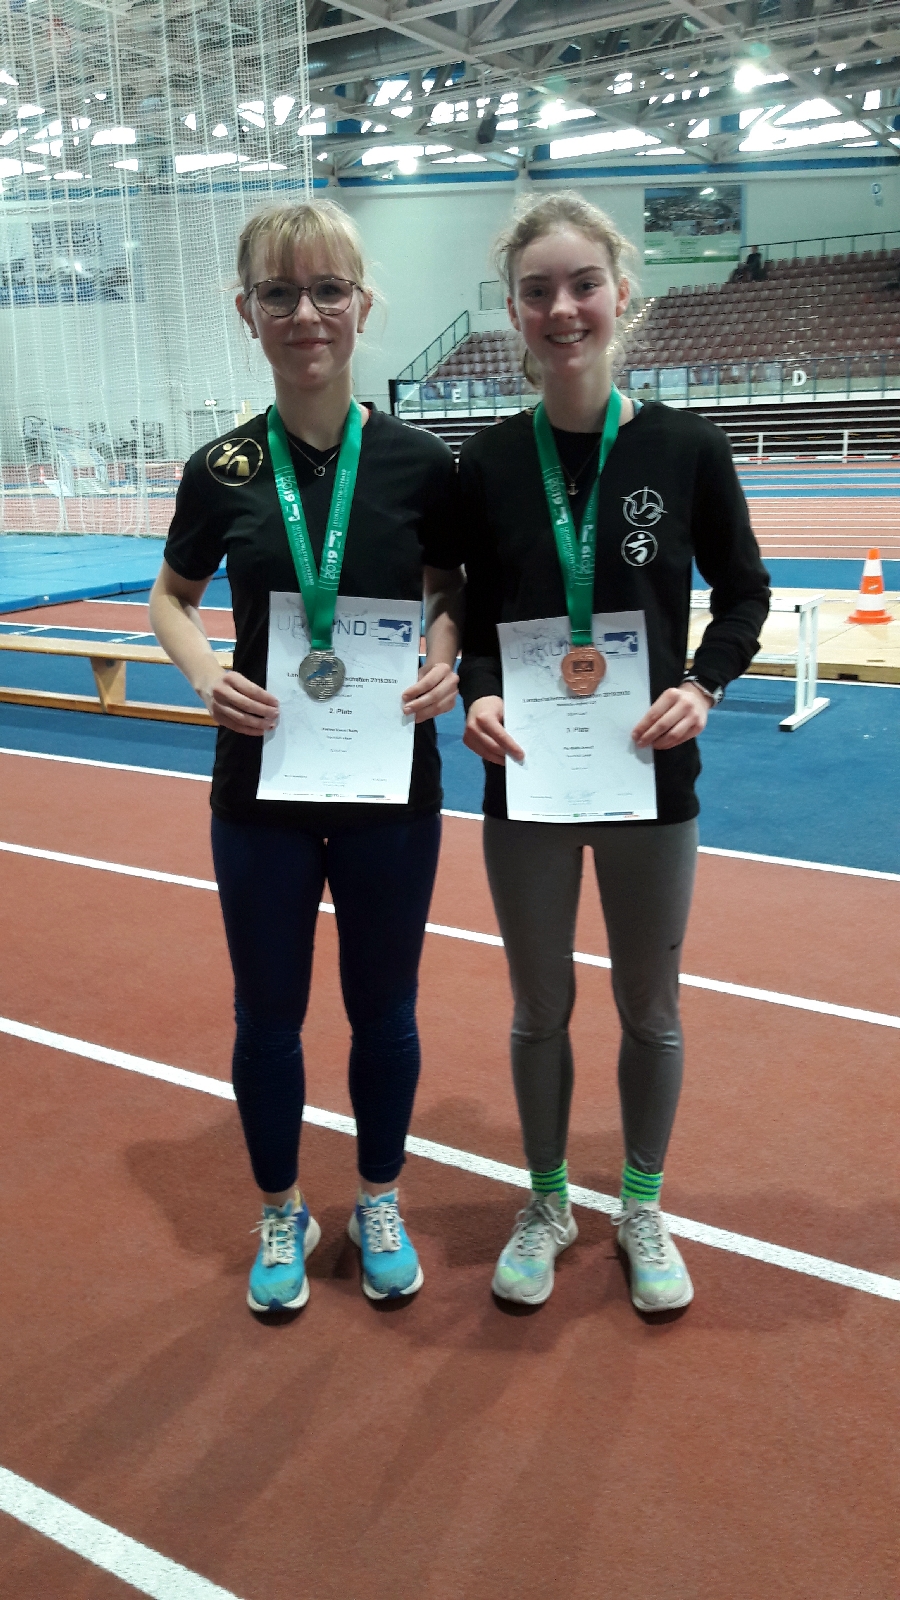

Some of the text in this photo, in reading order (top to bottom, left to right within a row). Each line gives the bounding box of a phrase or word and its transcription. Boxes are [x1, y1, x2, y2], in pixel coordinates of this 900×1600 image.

[791, 370, 807, 387] D
[451, 388, 462, 403] E
[281, 476, 296, 502] 2019
[325, 550, 339, 580] 2019
[277, 615, 379, 638] URNDE
